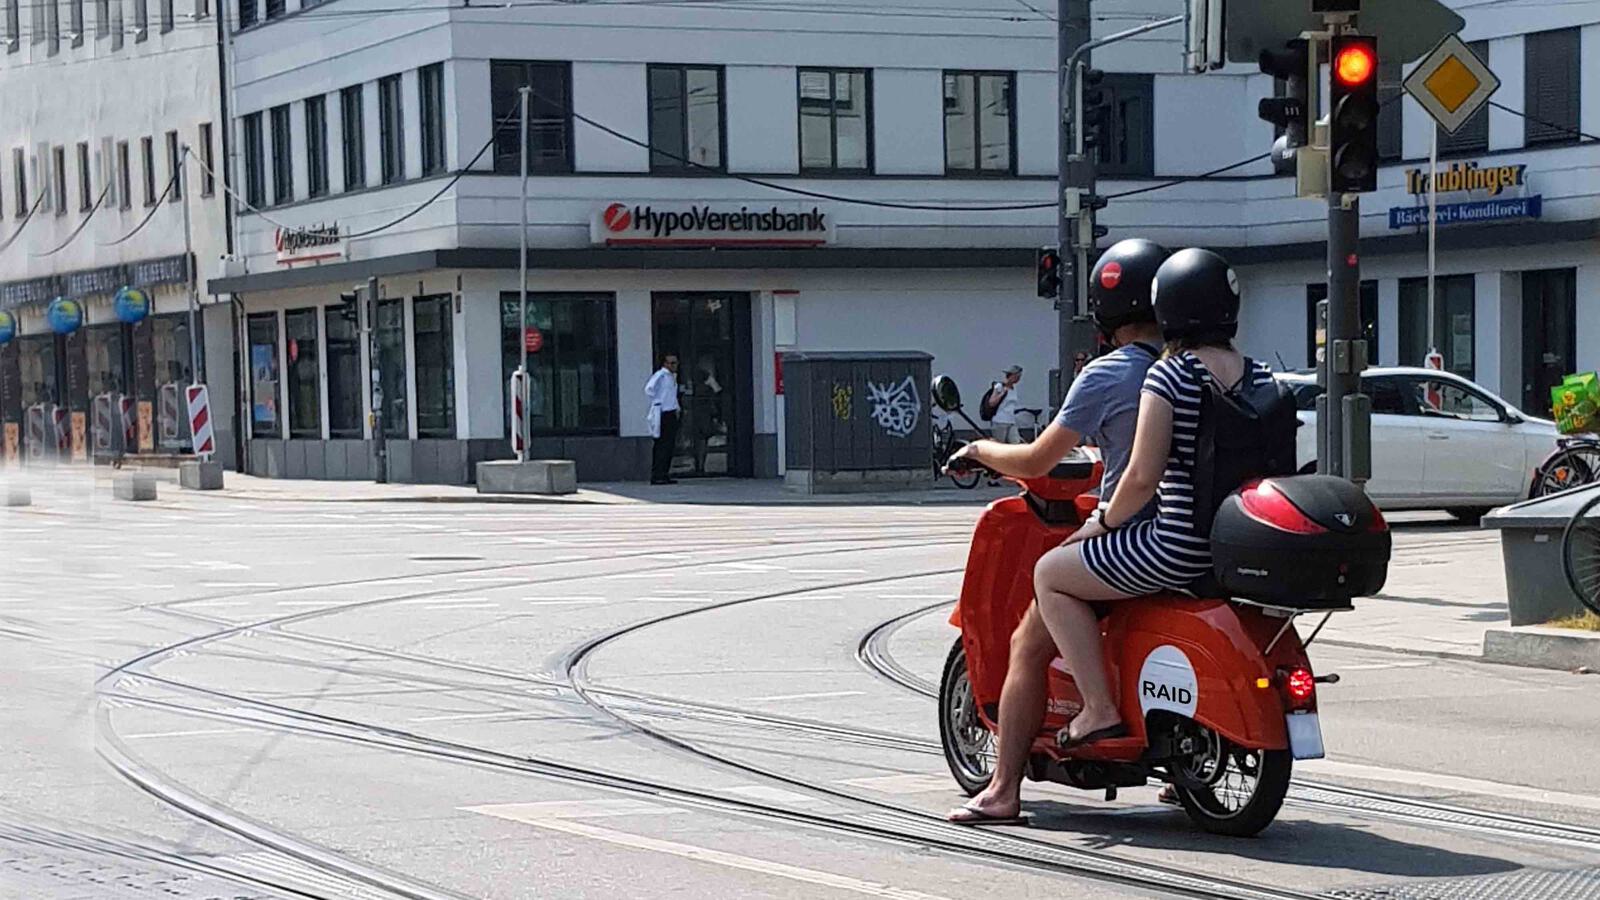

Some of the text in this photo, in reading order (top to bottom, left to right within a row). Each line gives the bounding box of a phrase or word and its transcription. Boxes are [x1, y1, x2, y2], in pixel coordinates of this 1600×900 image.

[634, 205, 827, 237] HypoVereinsbank
[1396, 206, 1452, 224] Bäckrei
[1142, 680, 1192, 705] RAID
